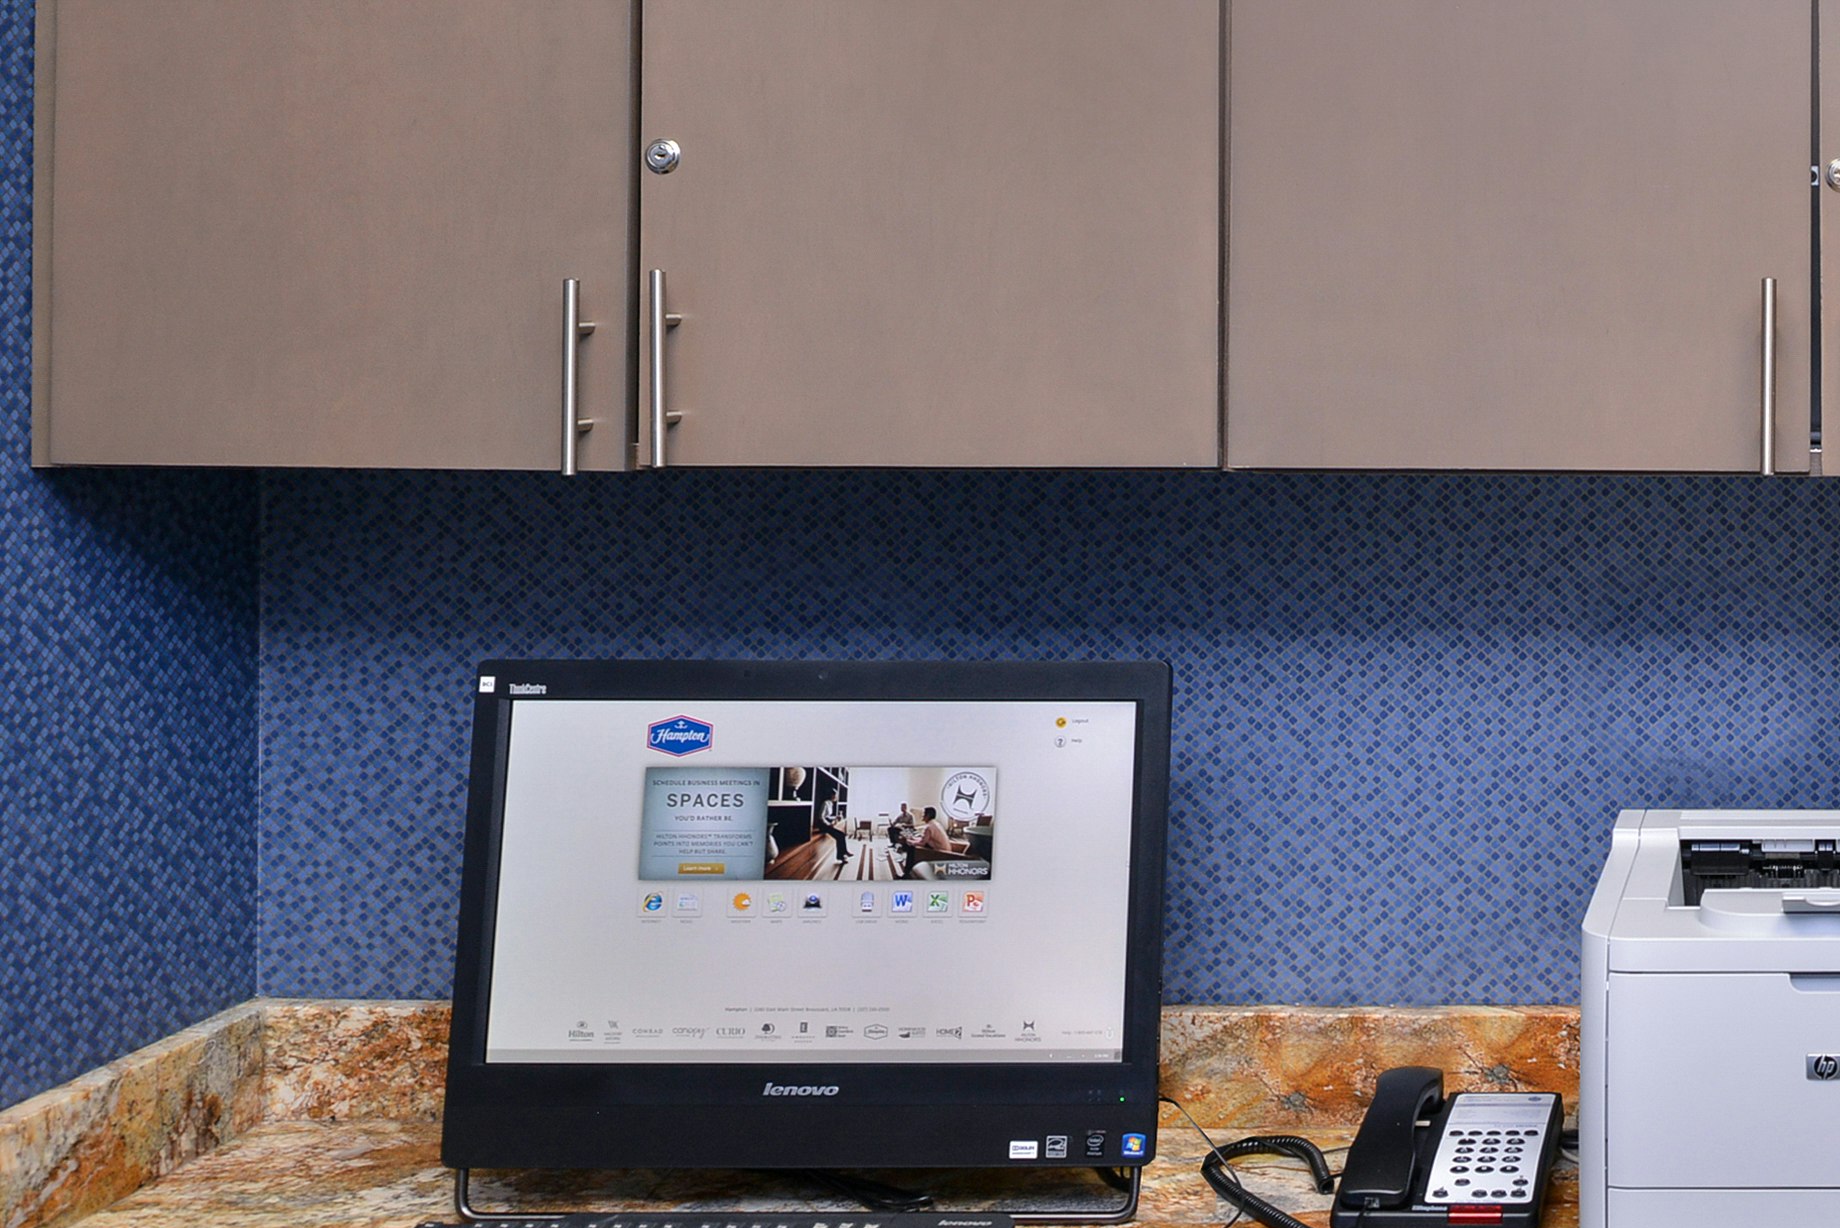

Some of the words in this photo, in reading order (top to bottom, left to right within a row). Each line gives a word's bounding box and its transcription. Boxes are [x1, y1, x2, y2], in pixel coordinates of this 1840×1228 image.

[651, 728, 711, 744] Hampton
[666, 793, 745, 808] SPACES
[762, 1082, 839, 1096] lenovo
